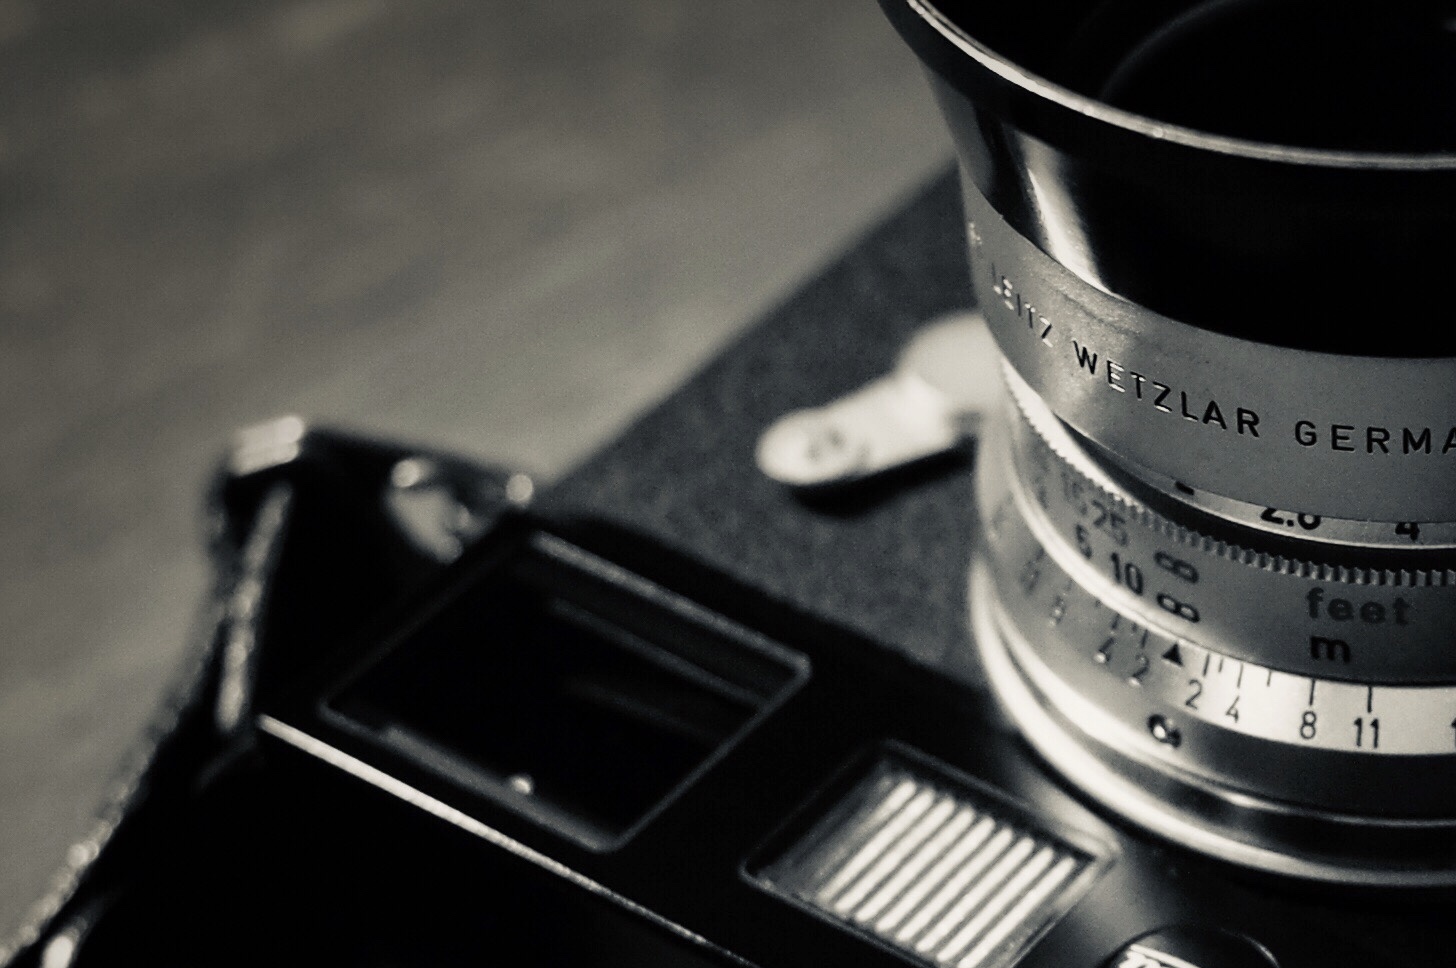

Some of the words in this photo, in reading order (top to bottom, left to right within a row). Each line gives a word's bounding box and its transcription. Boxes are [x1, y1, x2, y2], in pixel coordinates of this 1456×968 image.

[990, 262, 1053, 348] LEITZ
[1072, 339, 1260, 438] WETZLAR
[1091, 500, 1128, 548] 25
[1110, 551, 1143, 595] 10
[1305, 587, 1411, 626] feet
[1311, 635, 1352, 663] m
[1185, 679, 1203, 709] 2
[1225, 694, 1241, 724] 4
[1299, 711, 1317, 740] 8
[1353, 716, 1380, 749] 11
